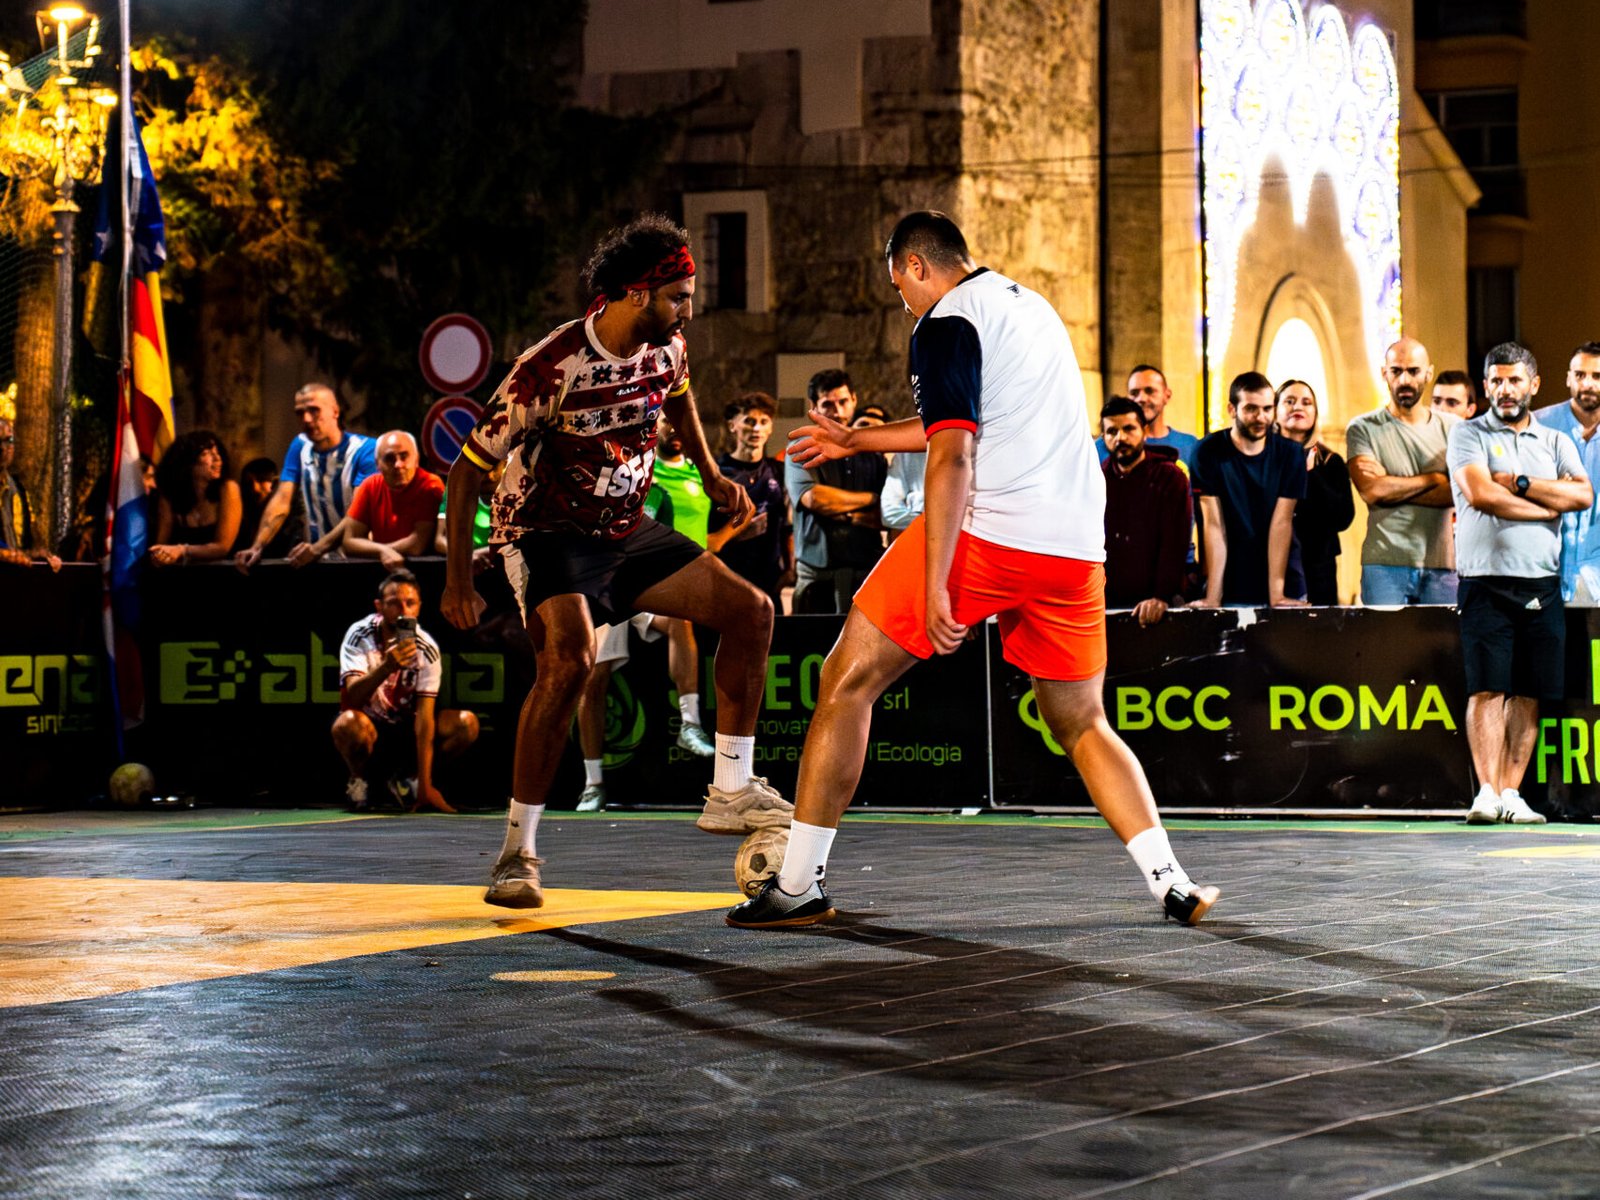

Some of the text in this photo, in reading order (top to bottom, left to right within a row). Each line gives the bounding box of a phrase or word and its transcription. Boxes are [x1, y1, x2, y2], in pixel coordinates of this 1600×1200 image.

[883, 687, 910, 710] srl
[1116, 685, 1457, 731] BCC ROMA
[1537, 718, 1600, 784] FR
